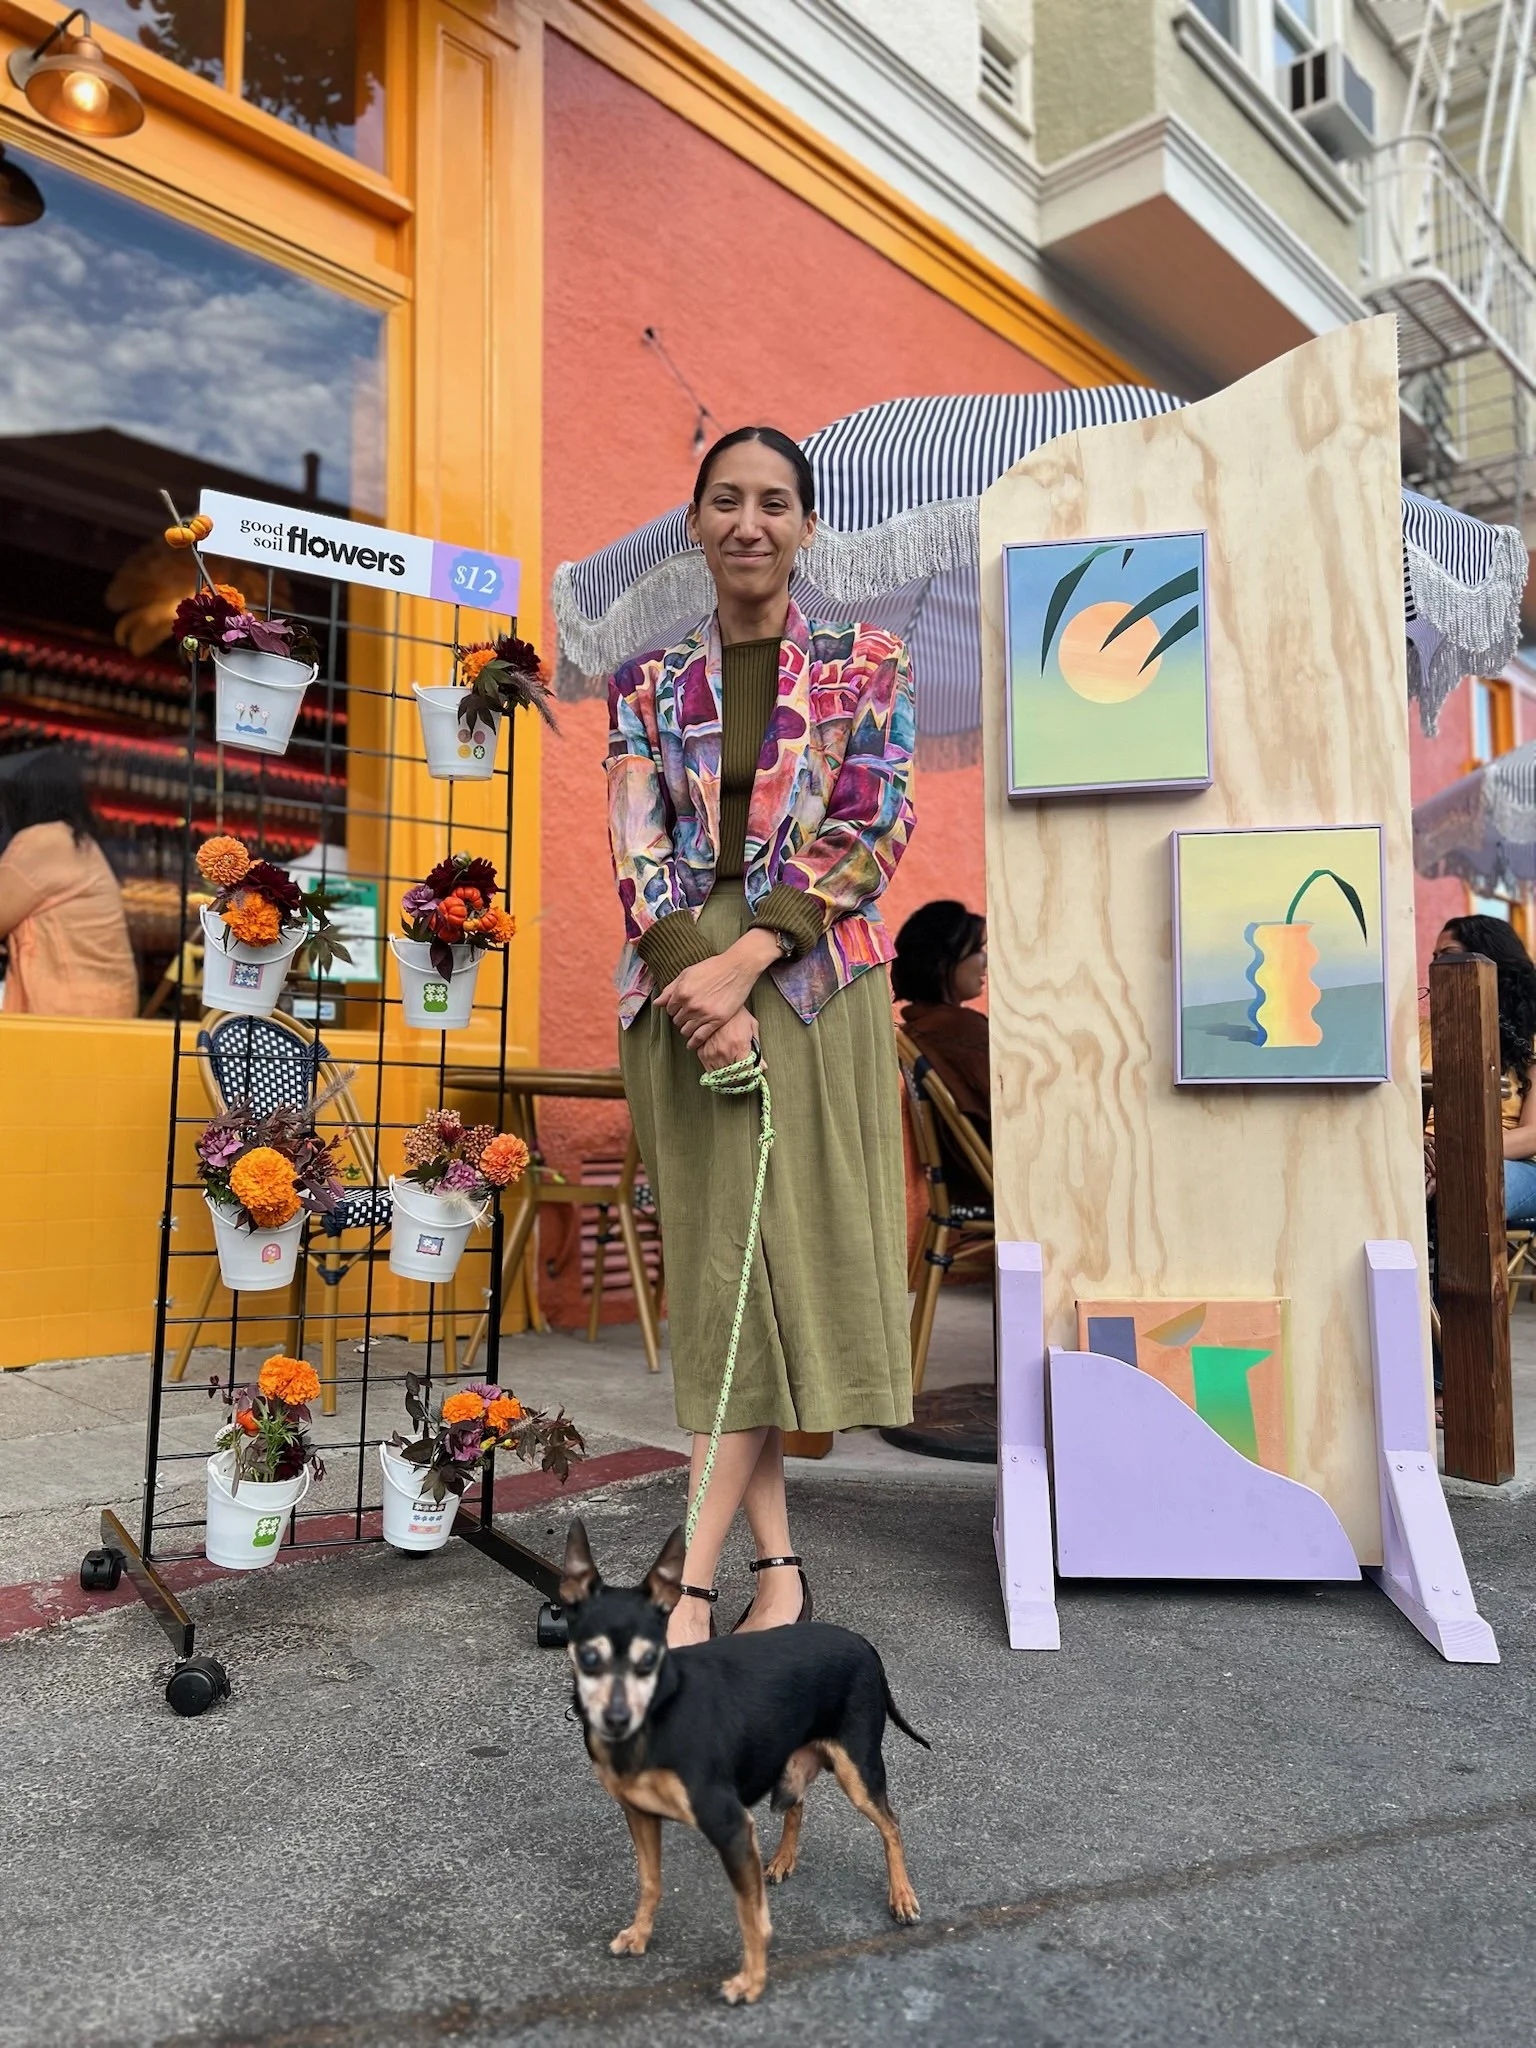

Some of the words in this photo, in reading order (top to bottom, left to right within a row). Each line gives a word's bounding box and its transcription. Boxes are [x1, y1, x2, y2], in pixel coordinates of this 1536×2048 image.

[240, 519, 283, 536] good
[253, 534, 283, 551] soil
[287, 525, 405, 576] flowers
[454, 564, 497, 594] $12
